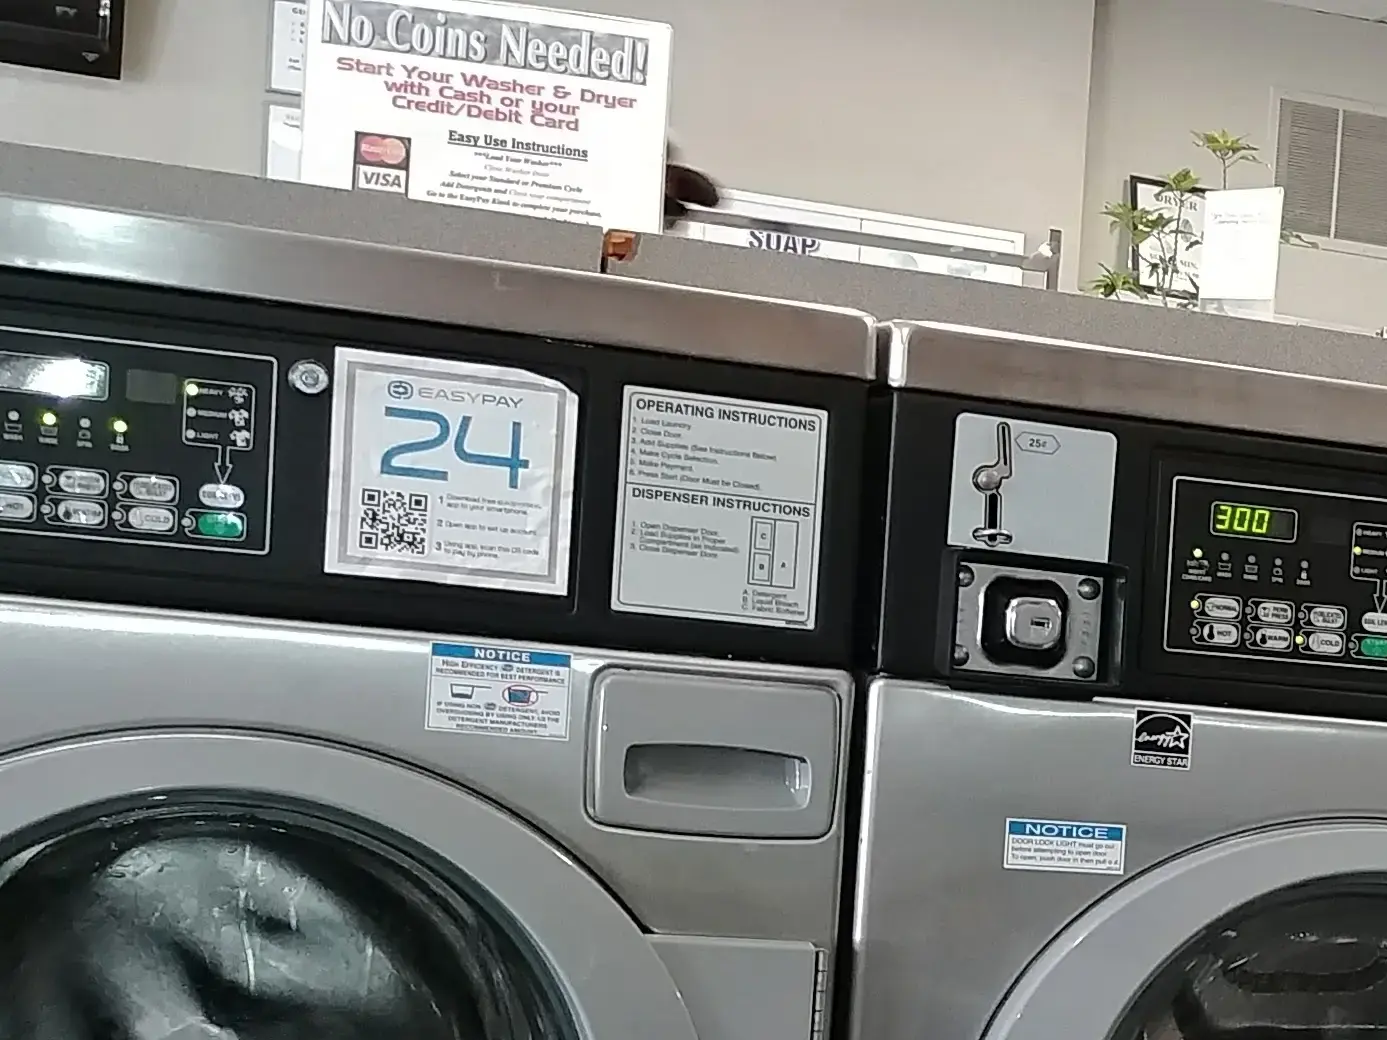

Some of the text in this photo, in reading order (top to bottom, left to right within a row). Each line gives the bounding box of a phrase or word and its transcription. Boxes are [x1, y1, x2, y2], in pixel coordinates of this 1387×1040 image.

[321, 1, 649, 86] No Coins Needed!
[336, 56, 637, 109] Start Your Washer & Dryer
[384, 79, 580, 116] with Cash or your
[391, 96, 580, 131] Credit/Debit Card
[447, 130, 588, 159] Easy Use Instructions
[363, 171, 401, 188] VISA
[746, 229, 820, 256] SOAP
[418, 386, 523, 409] EASYPAY
[636, 398, 816, 431] OPERATING INSTRUCTIONS
[380, 406, 530, 489] 24
[632, 488, 810, 517] DISPENSER INSTRUCTIONS
[1215, 505, 1270, 534] 300
[473, 647, 531, 663] NOTICE
[1320, 639, 1340, 647] COLD
[1134, 755, 1165, 765] ENERGY
[1012, 838, 1033, 846] DOOR
[1025, 824, 1108, 839] NOTICE
